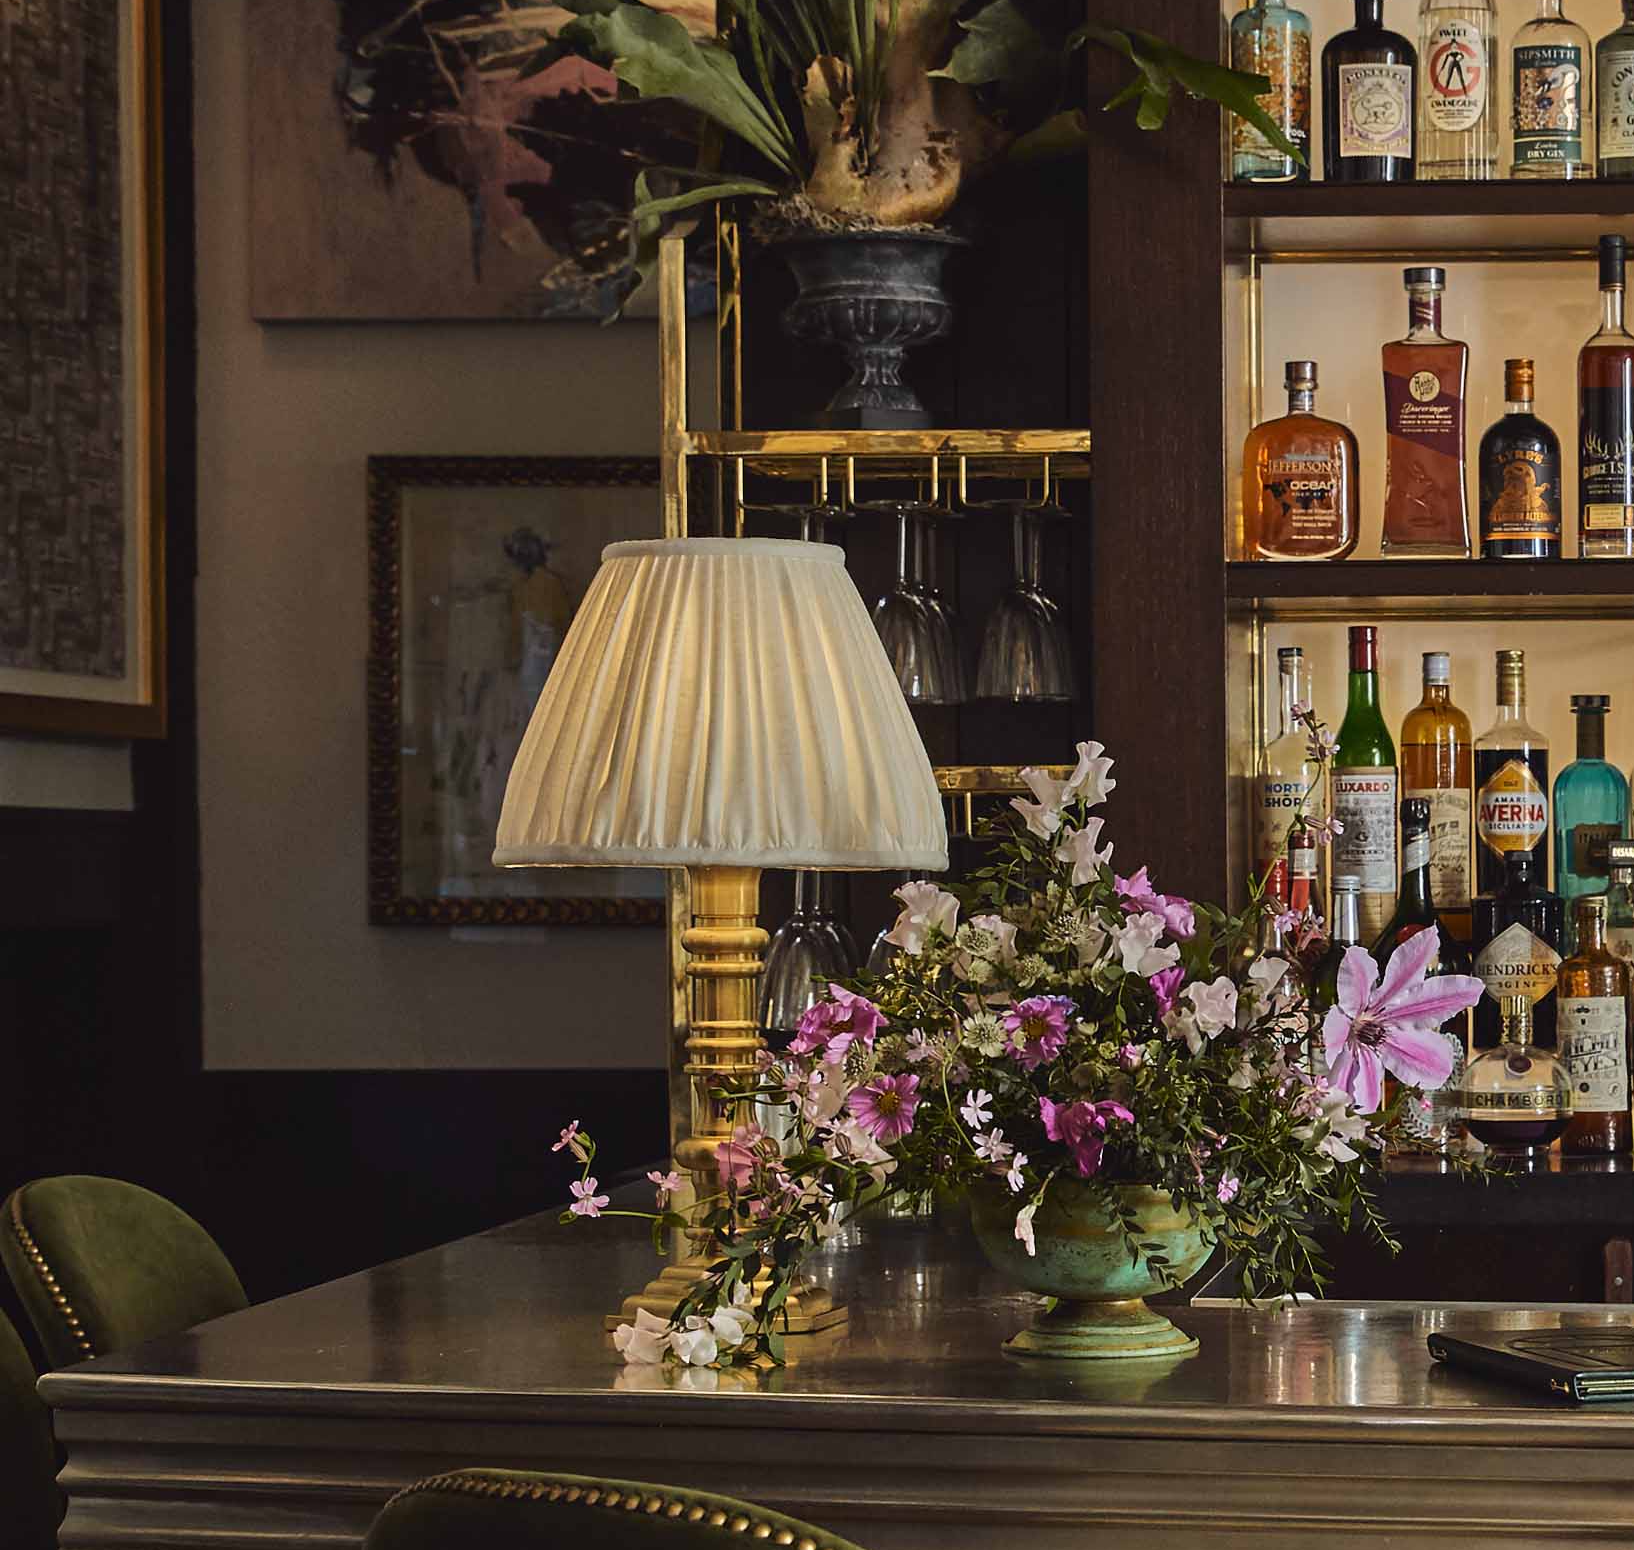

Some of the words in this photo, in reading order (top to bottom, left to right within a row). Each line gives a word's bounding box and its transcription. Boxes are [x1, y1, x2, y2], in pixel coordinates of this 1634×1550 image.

[1519, 48, 1576, 60] SIPSMITH
[1534, 142, 1558, 150] London
[1527, 149, 1545, 159] DRY
[1546, 149, 1565, 159] GIN
[1264, 459, 1339, 475] JEFFERSON'S
[1290, 481, 1337, 490] OCEAN
[1263, 783, 1311, 794] NORTH
[1335, 782, 1390, 793] LUXARDO
[1479, 803, 1545, 822] AVERNA
[1477, 963, 1558, 976] HENDRICK'S
[1475, 1093, 1564, 1107] CHAMBORD
